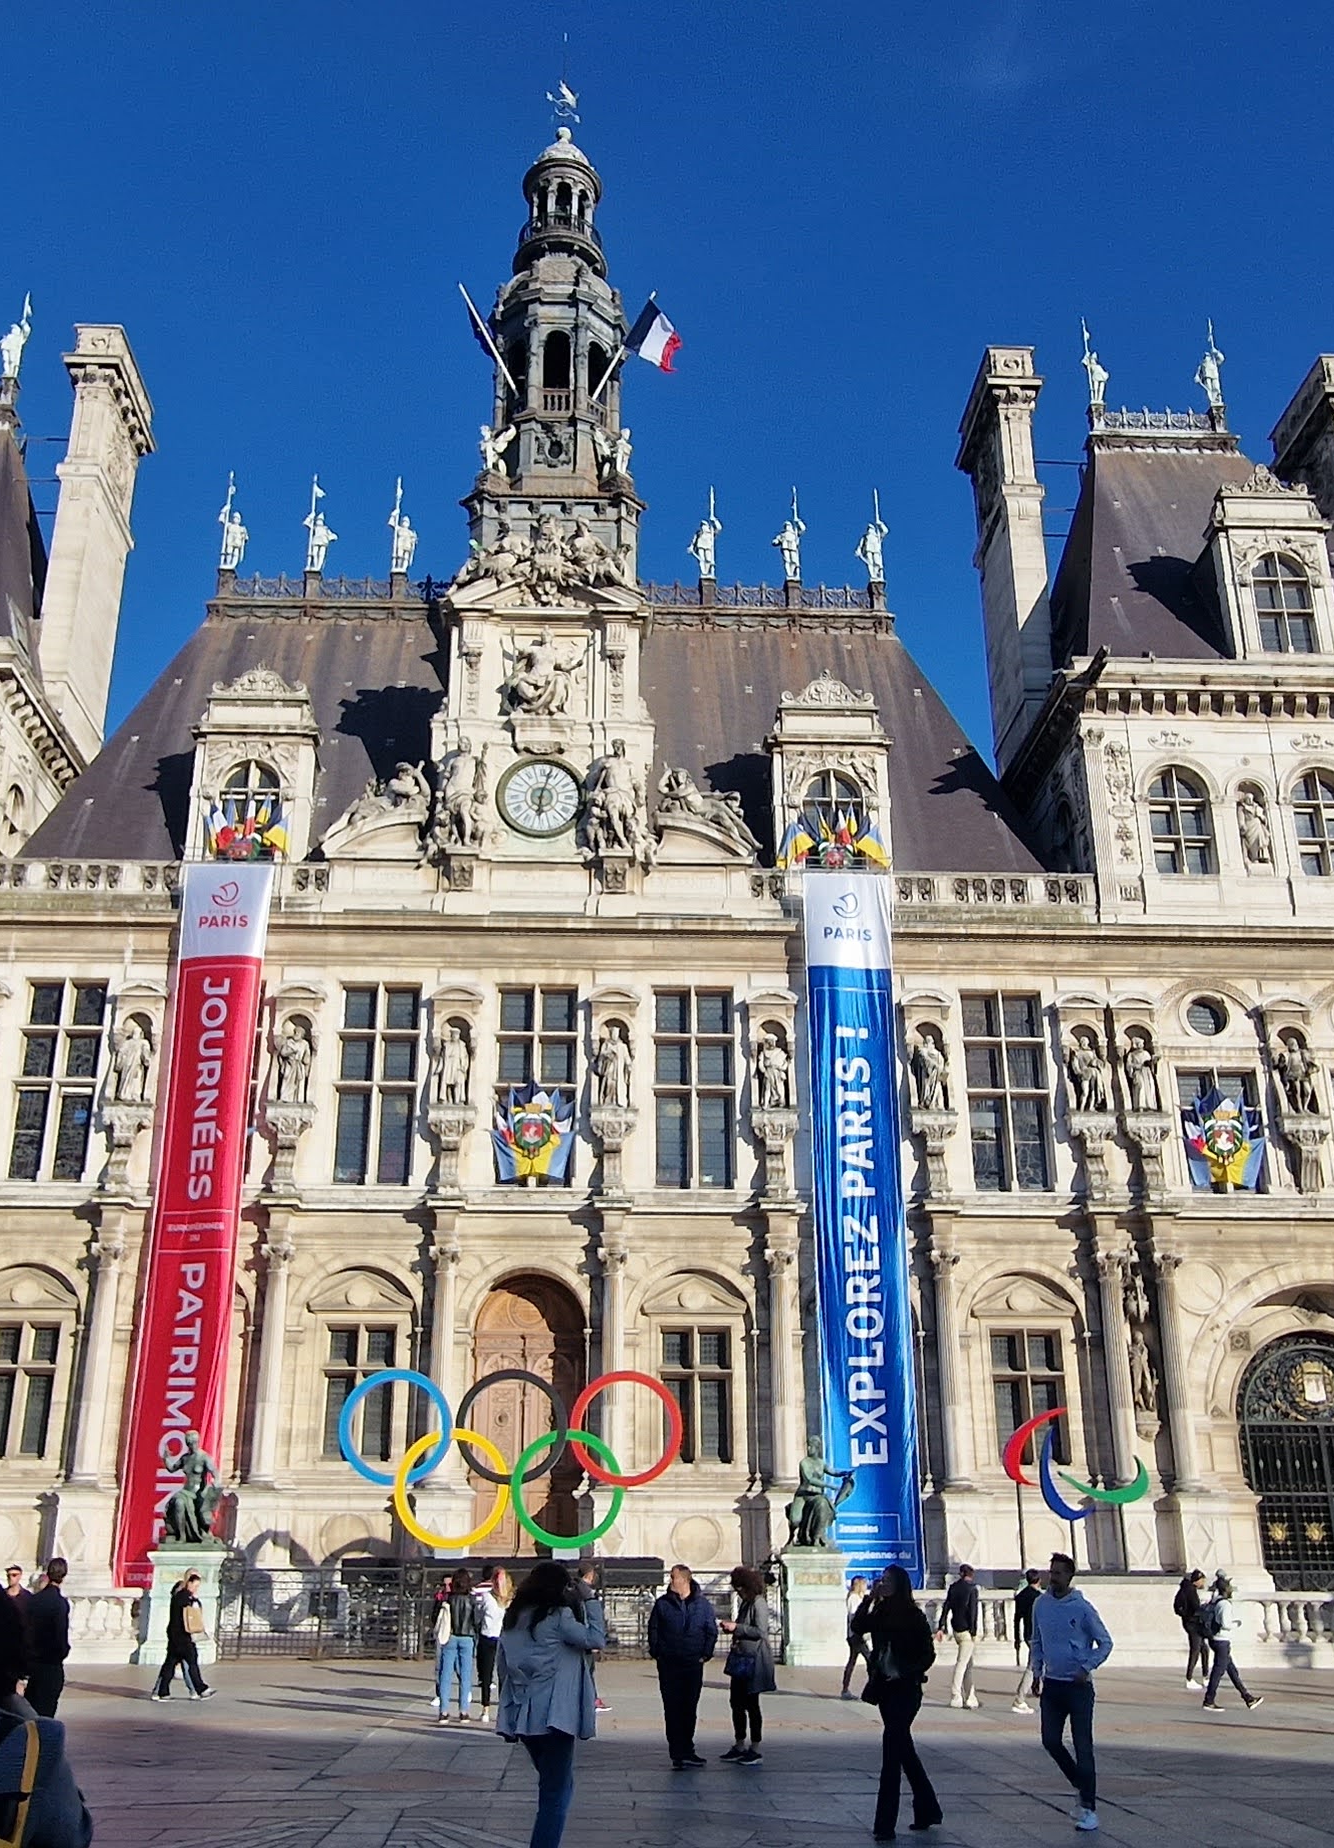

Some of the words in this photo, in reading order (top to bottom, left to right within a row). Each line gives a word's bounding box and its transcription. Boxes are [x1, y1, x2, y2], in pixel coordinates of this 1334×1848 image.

[198, 914, 248, 928] PARIS
[823, 926, 872, 941] PARIS
[187, 976, 230, 1201] JOURNÉES
[835, 1056, 876, 1197] PARIS
[843, 1214, 888, 1466] EXPLOREZ
